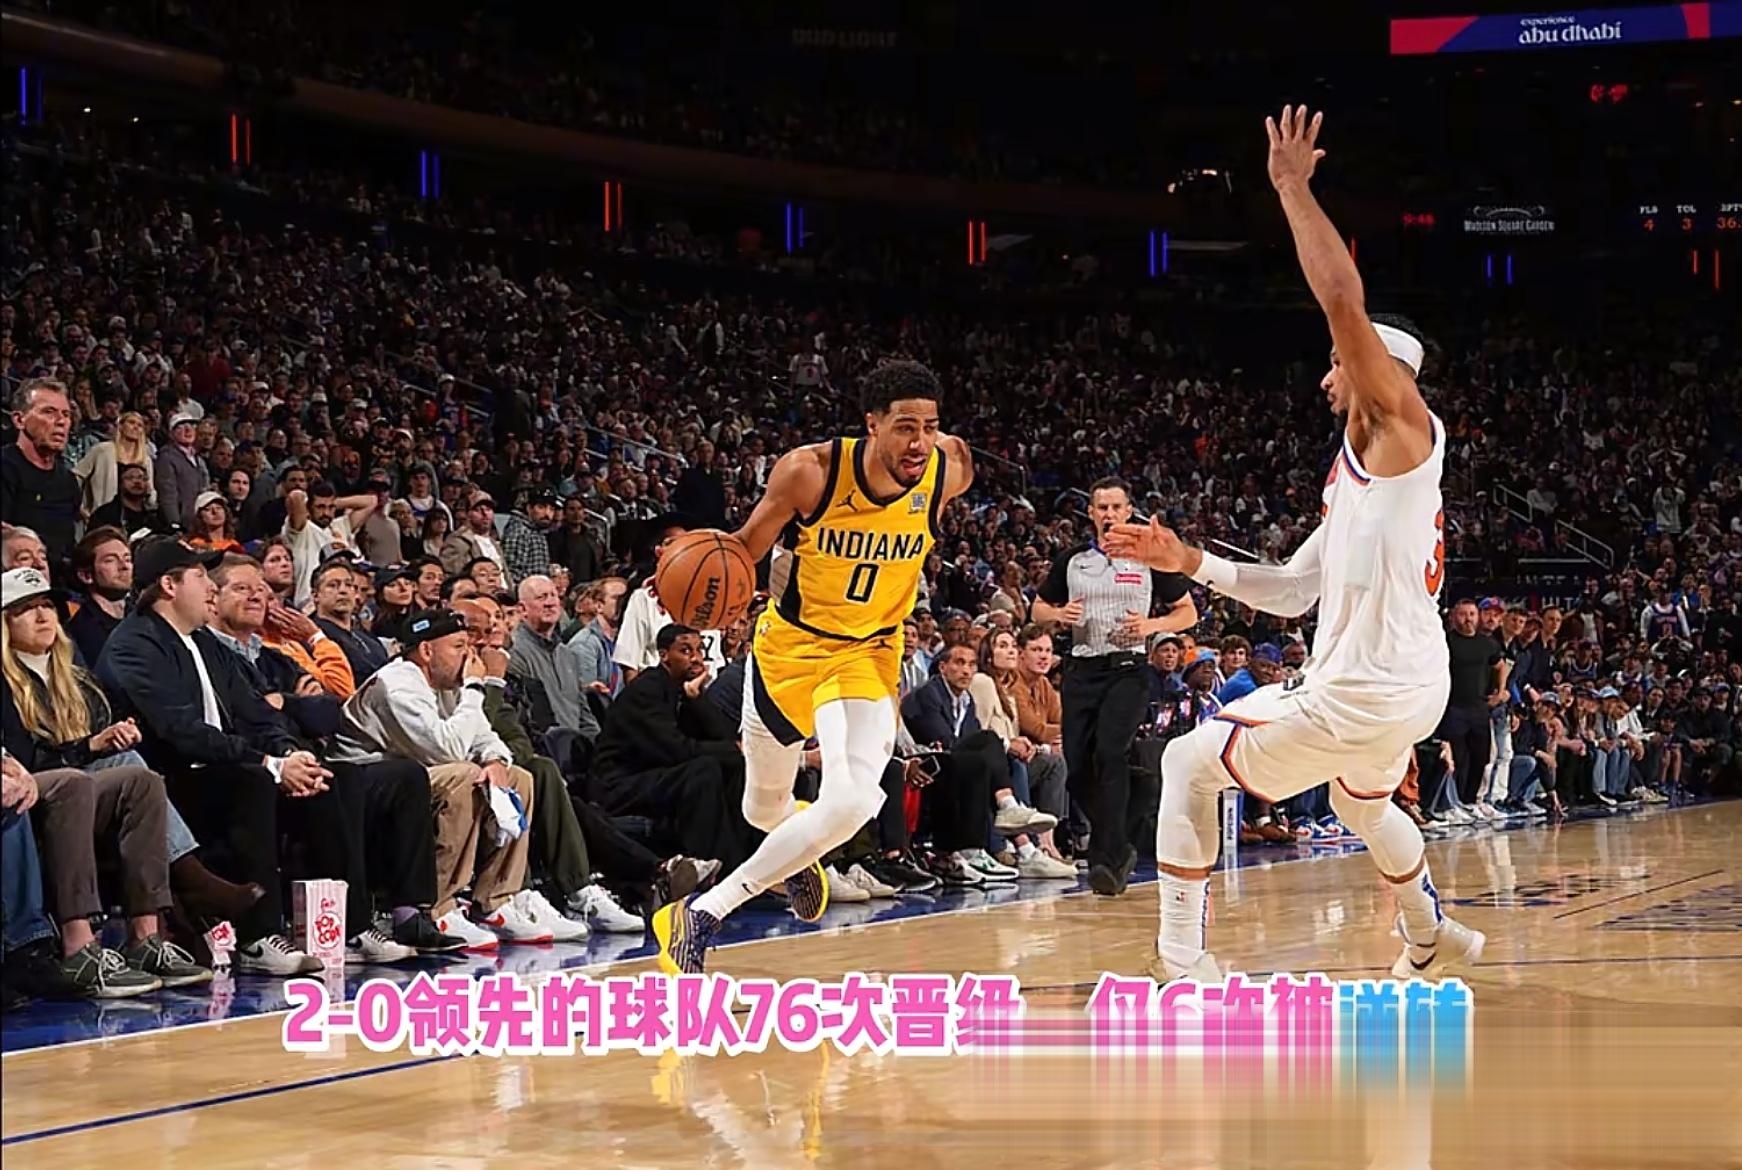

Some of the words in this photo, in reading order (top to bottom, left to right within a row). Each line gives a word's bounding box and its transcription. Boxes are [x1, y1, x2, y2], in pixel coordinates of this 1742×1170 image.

[1518, 26, 1559, 44] abu
[1561, 21, 1622, 41] dhabi
[817, 526, 925, 562] INDIANA
[845, 562, 881, 604] 0
